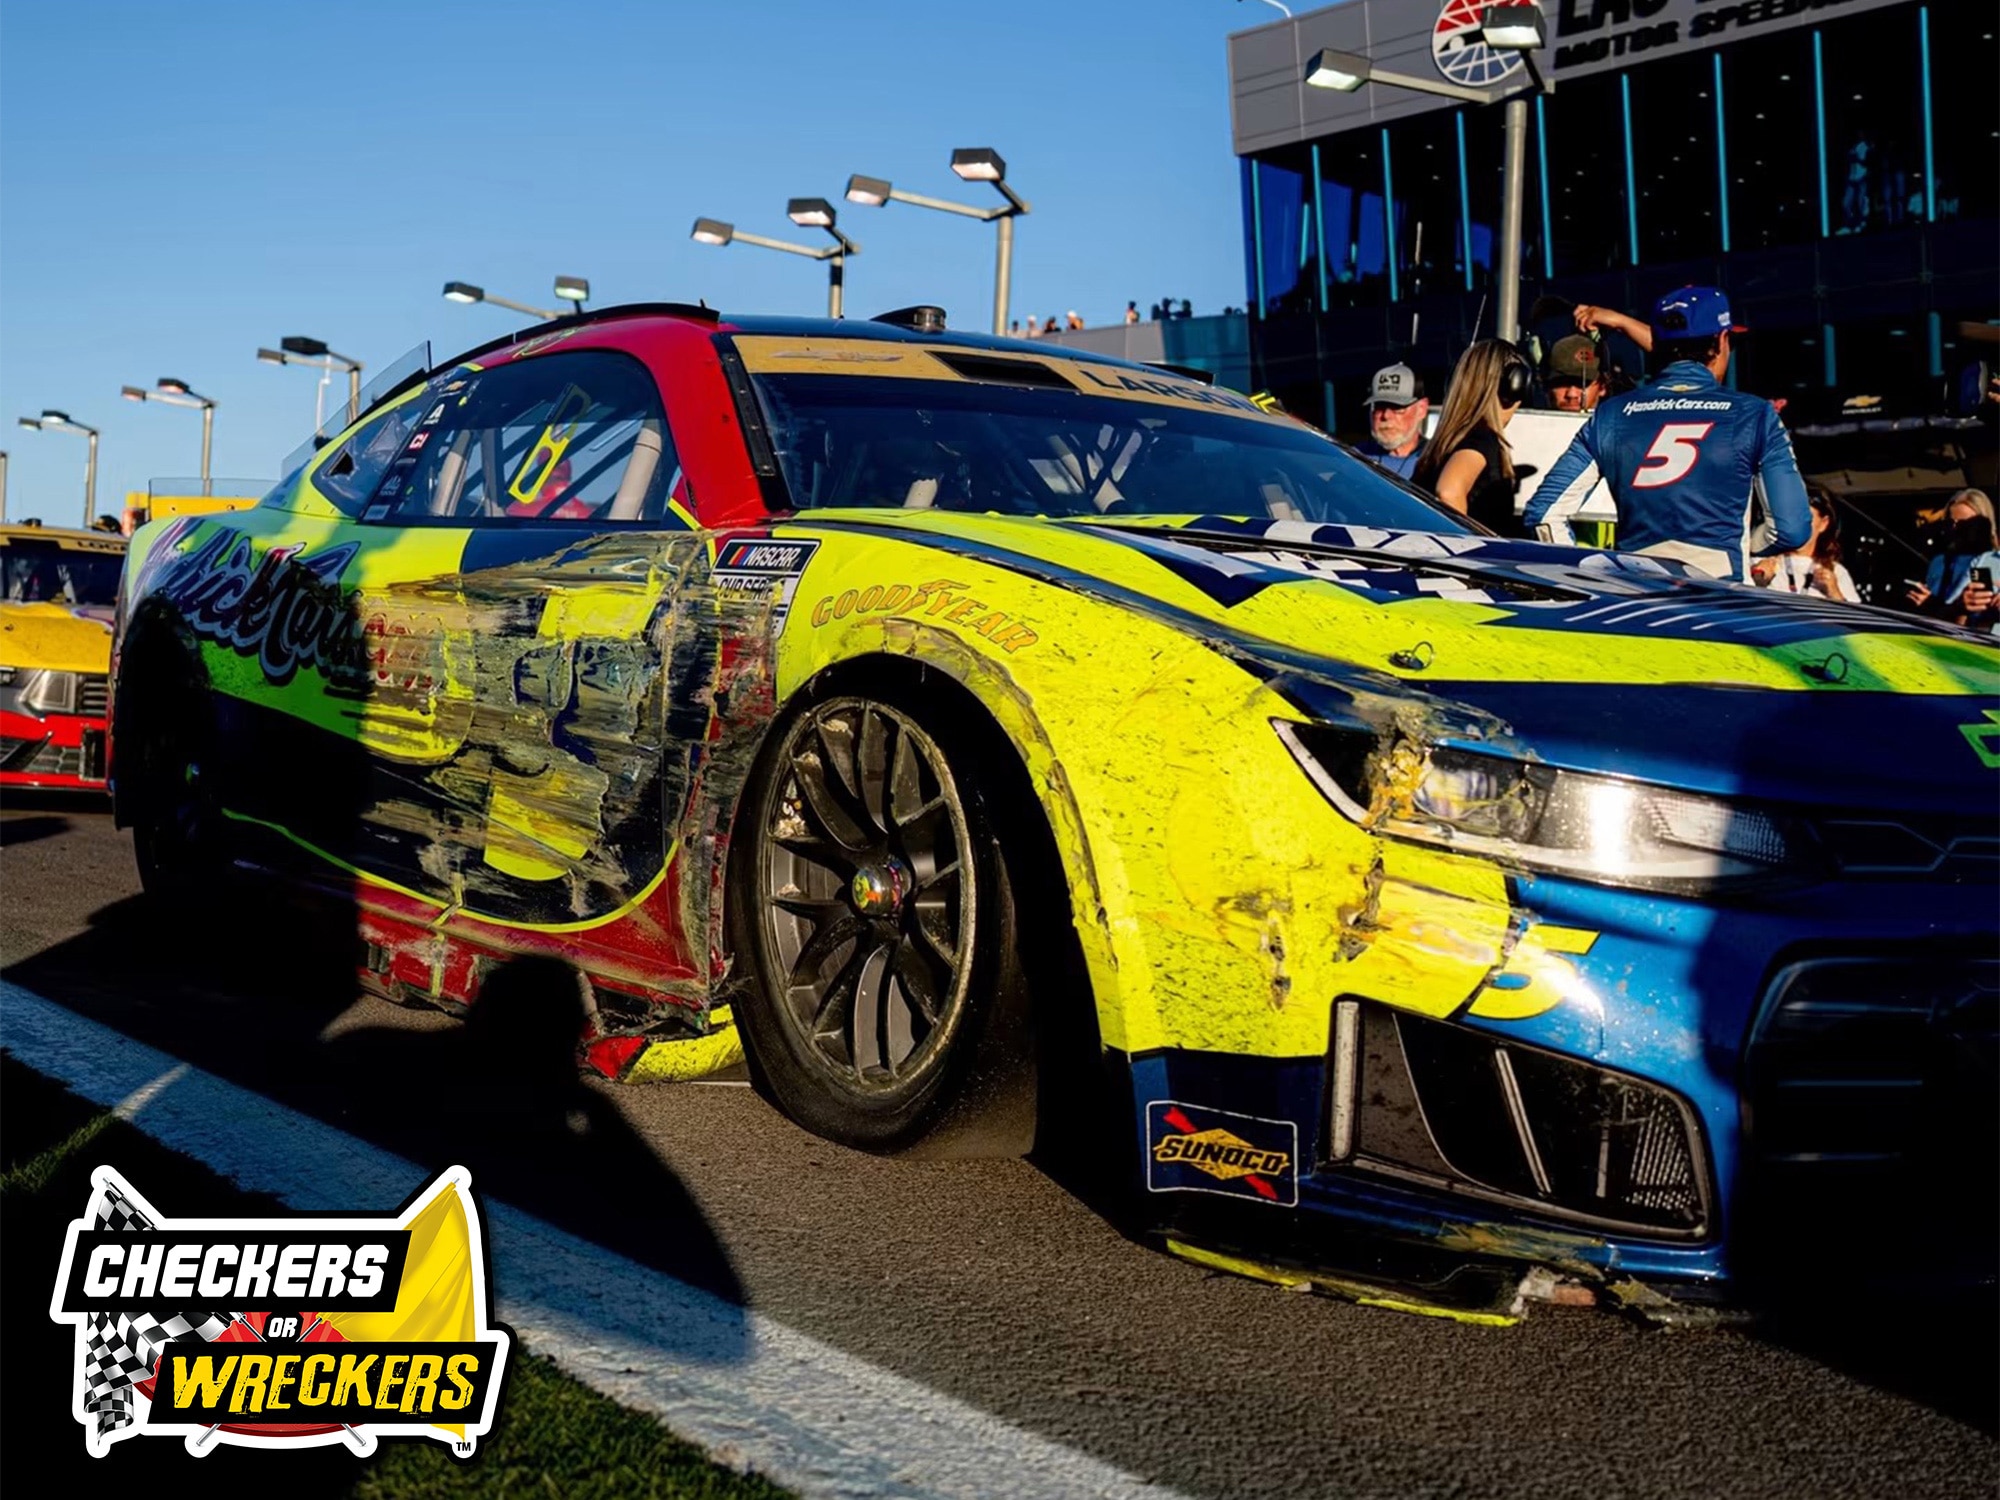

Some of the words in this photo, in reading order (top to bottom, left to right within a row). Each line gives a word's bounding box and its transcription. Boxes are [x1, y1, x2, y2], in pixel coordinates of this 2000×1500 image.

[1554, 21, 1679, 70] MOTOR
[1079, 369, 1269, 416] LARSON
[1622, 398, 1732, 416] HendrickCars.com
[1631, 421, 1716, 489] 5
[739, 545, 803, 568] NASCAR
[811, 582, 1039, 654] GOODYEAR
[1467, 921, 1601, 1021] 5
[1158, 1137, 1284, 1173] SUNOCO
